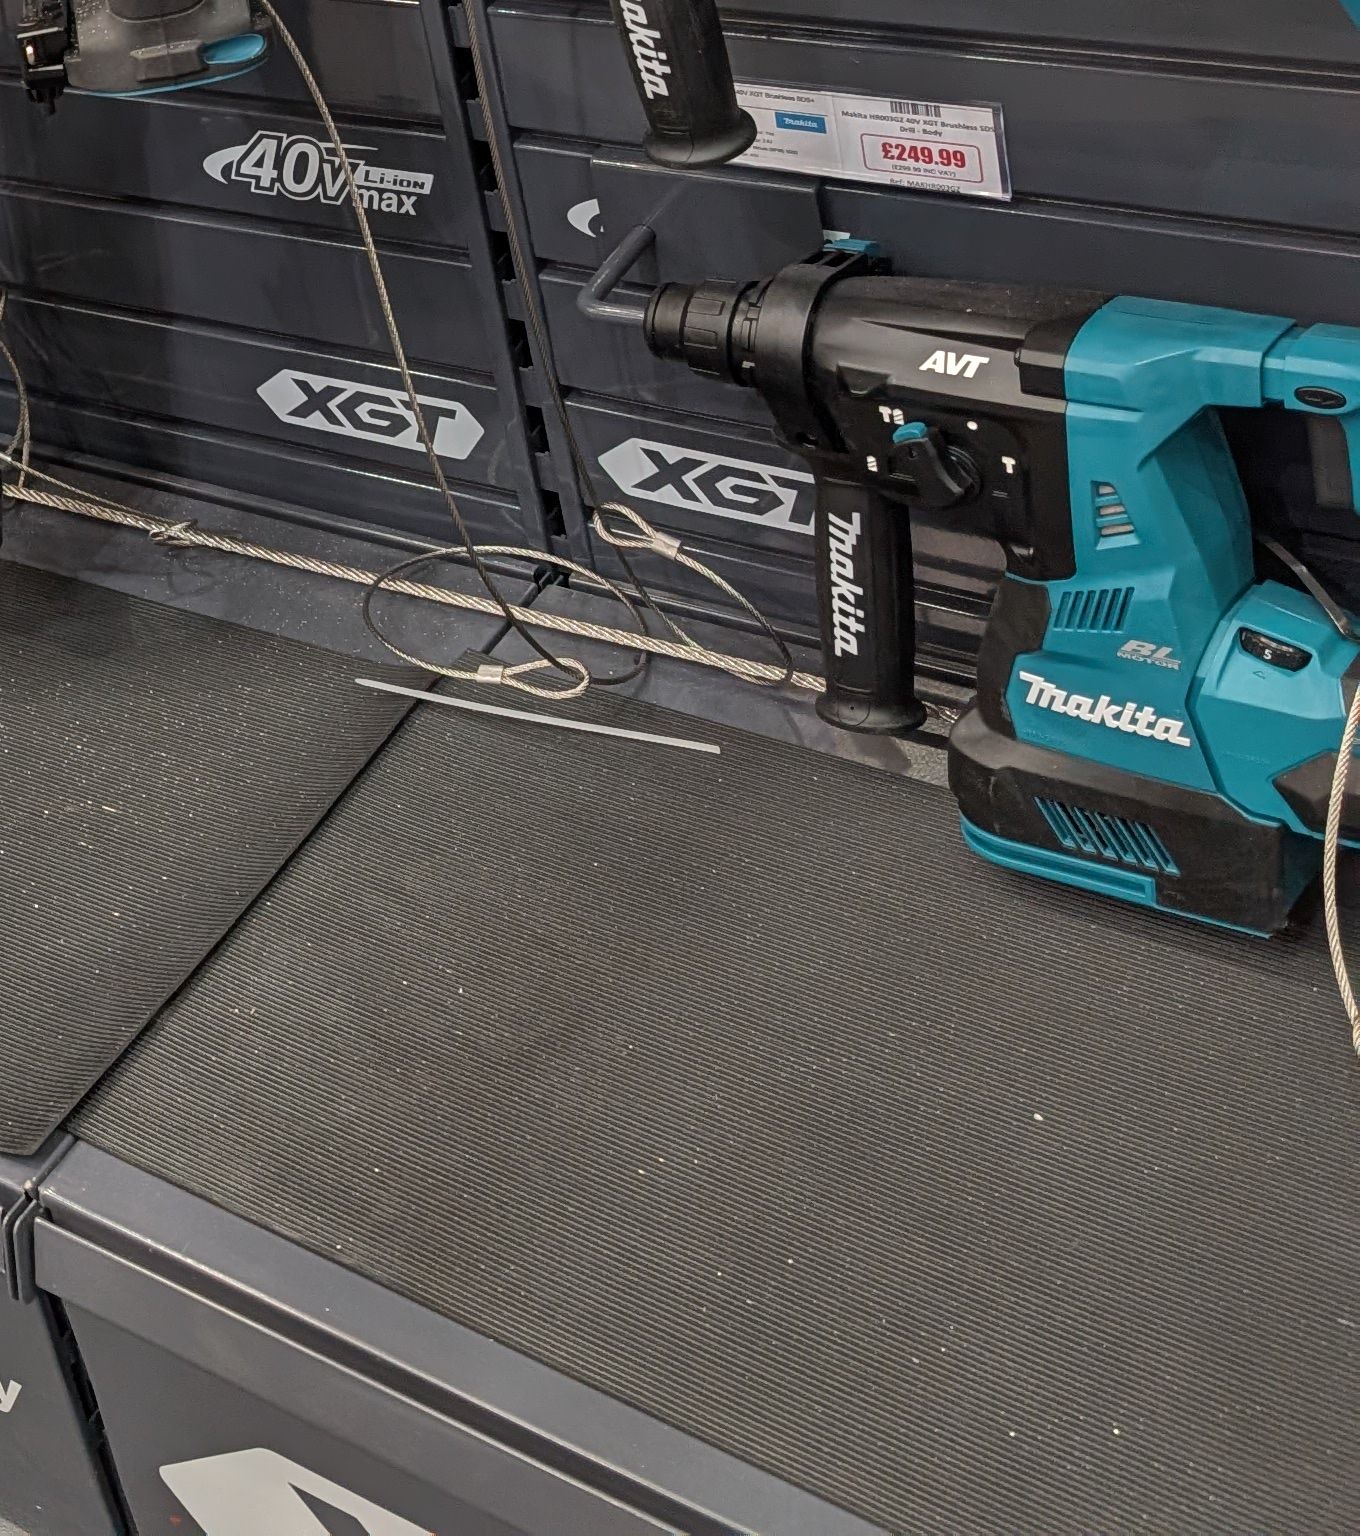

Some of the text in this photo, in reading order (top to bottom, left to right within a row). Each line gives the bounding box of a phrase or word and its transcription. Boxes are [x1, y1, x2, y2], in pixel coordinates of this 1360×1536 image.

[841, 109, 868, 121] Makita
[905, 116, 920, 126] 40V
[921, 118, 939, 128] XGT
[940, 119, 978, 132] Brushless
[899, 124, 943, 138] Drill Body
[880, 141, 966, 169] £249.99
[363, 171, 426, 190] Li-ion
[937, 168, 957, 178] VAT)
[359, 186, 417, 216] max
[918, 349, 991, 379] AVT
[287, 378, 458, 452] XGT
[1262, 648, 1273, 661] 5
